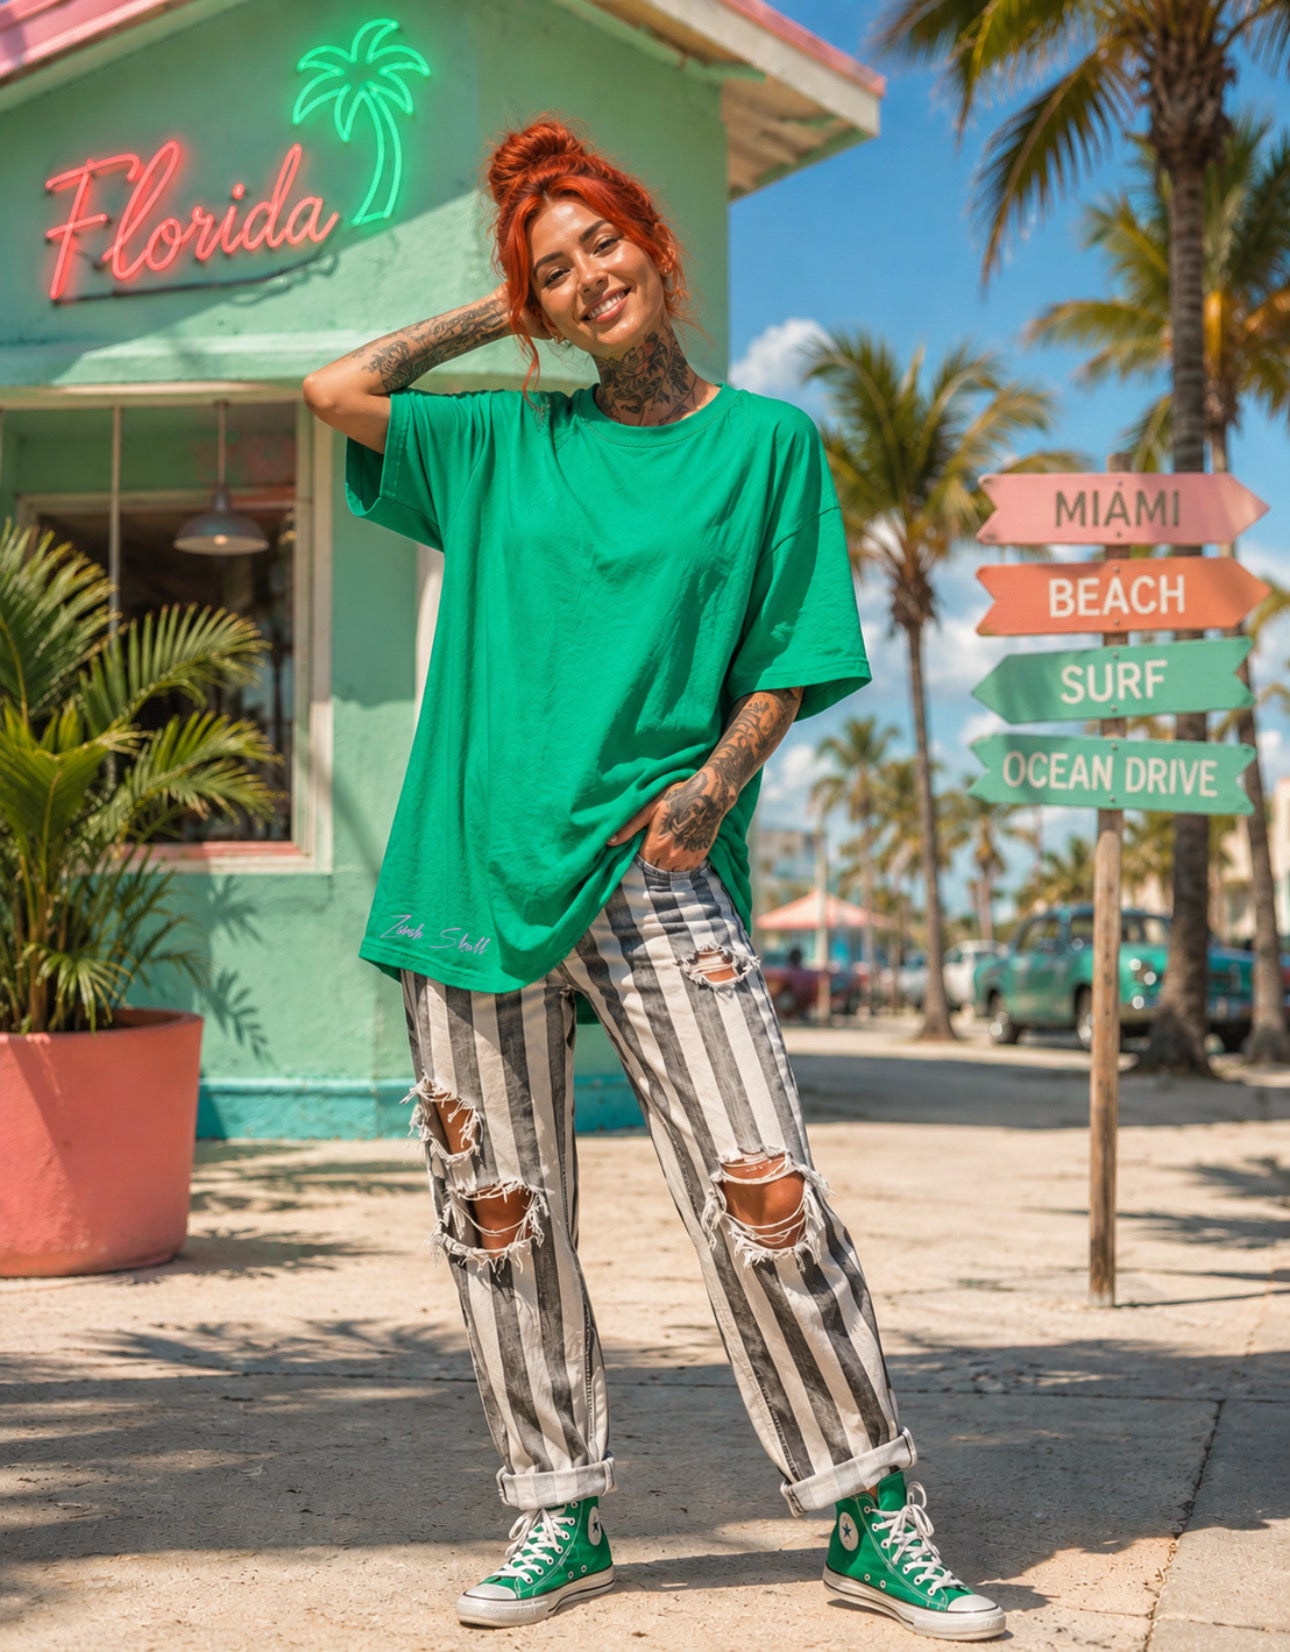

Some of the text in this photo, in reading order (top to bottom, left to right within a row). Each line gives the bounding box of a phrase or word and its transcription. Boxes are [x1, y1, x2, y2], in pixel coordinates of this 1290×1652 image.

[46, 140, 339, 299] Florida
[1055, 490, 1180, 527] MIAMI
[1048, 574, 1185, 618] BEACH
[1060, 659, 1168, 704] SURF
[1002, 751, 1218, 797] OCEAN DRIVE
